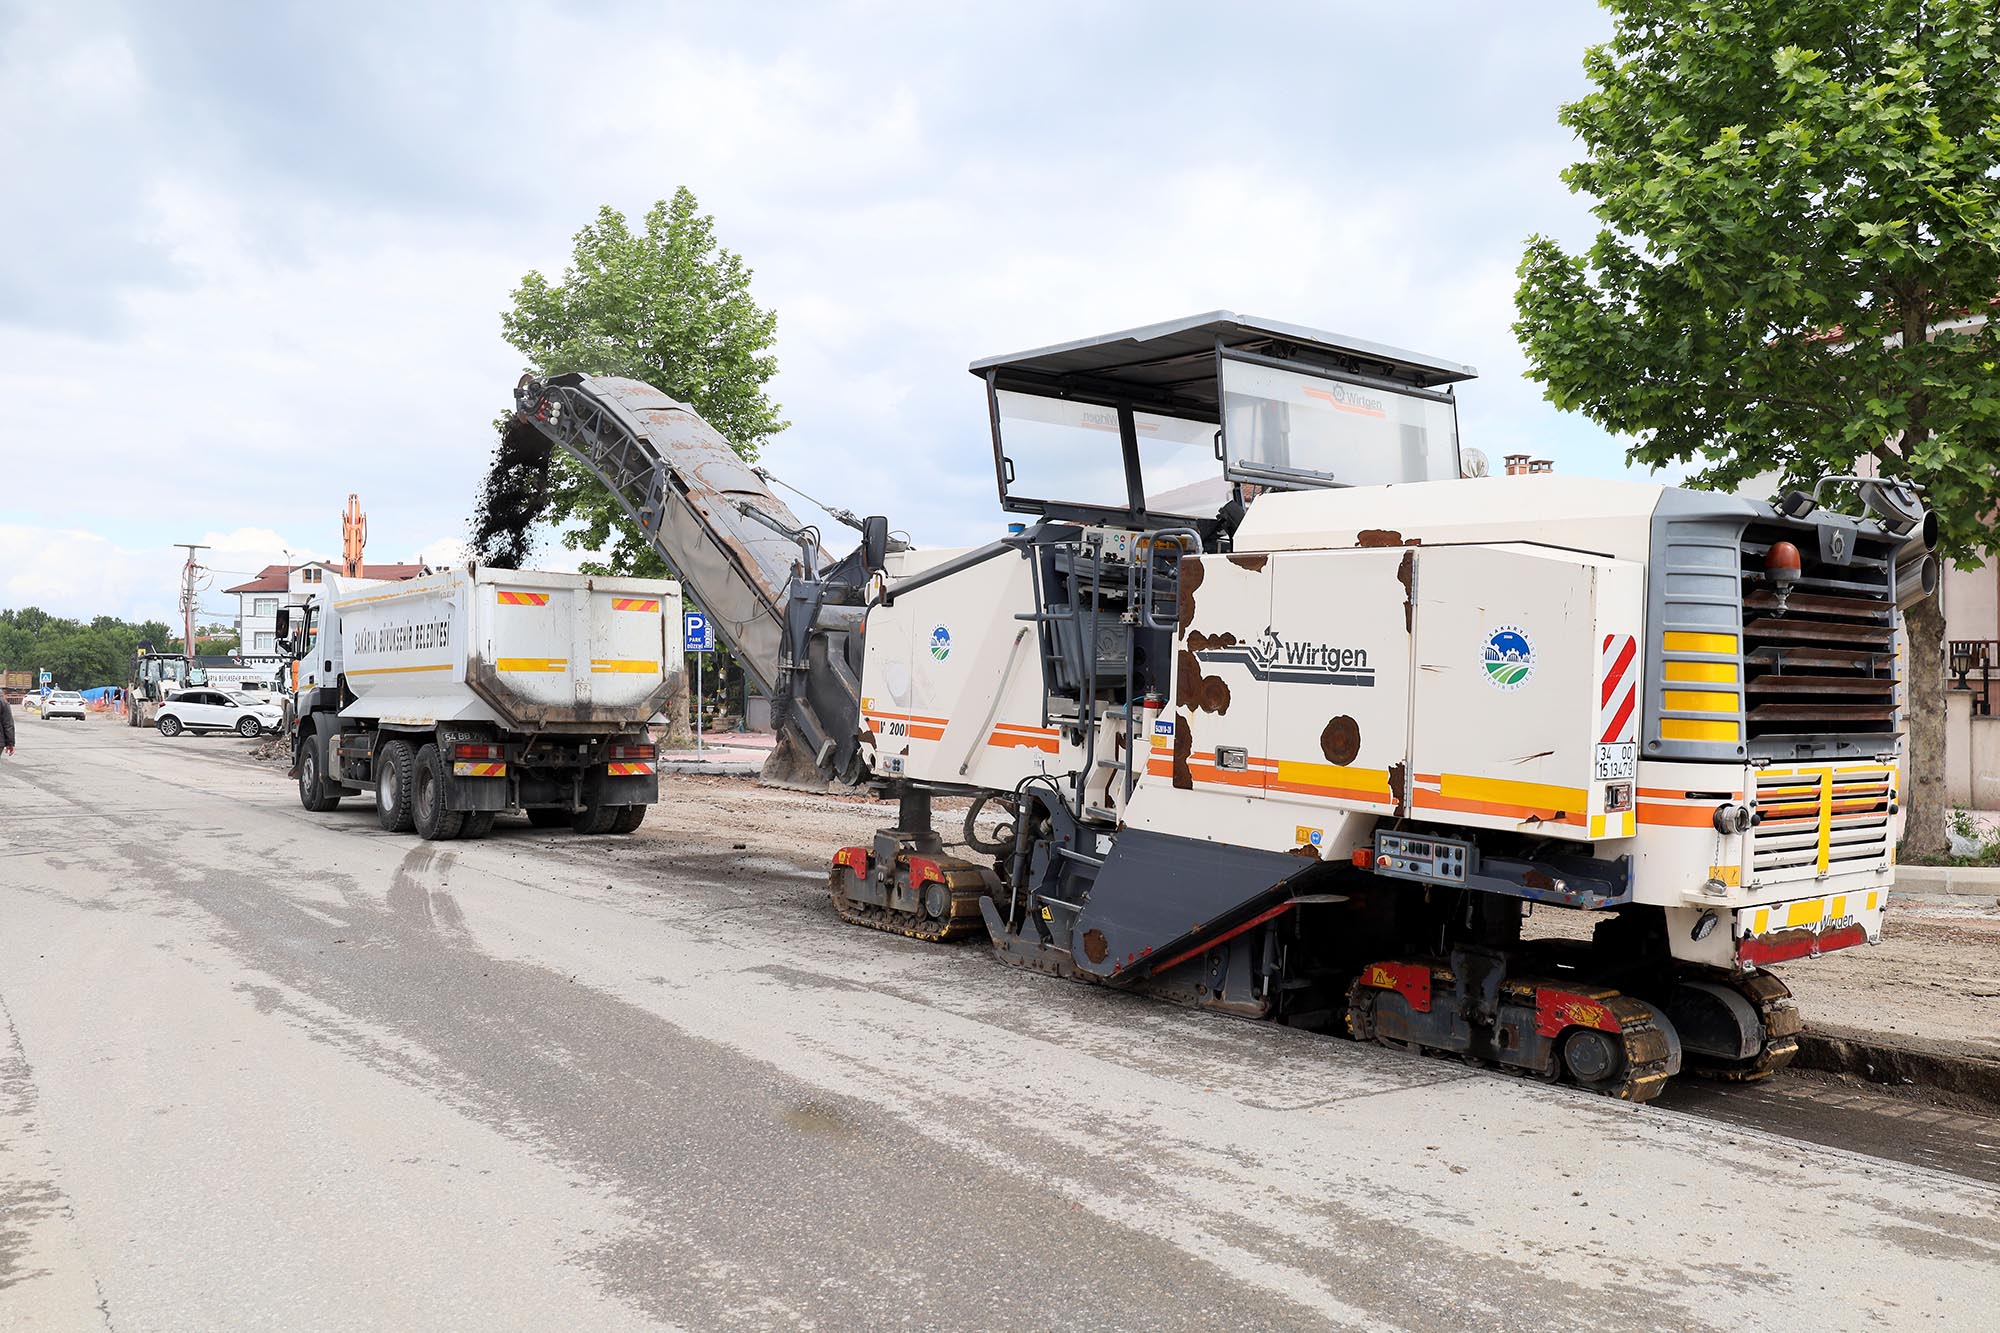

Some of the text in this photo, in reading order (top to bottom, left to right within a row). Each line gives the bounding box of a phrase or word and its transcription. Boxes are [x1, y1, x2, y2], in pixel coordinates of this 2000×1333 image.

[1346, 391, 1382, 409] Wirtgen
[415, 613, 450, 650] BELEDİYESİ
[687, 617, 703, 636] P
[1285, 641, 1367, 673] Wirtgen
[444, 732, 456, 741] 54
[1600, 745, 1633, 761] 34 00
